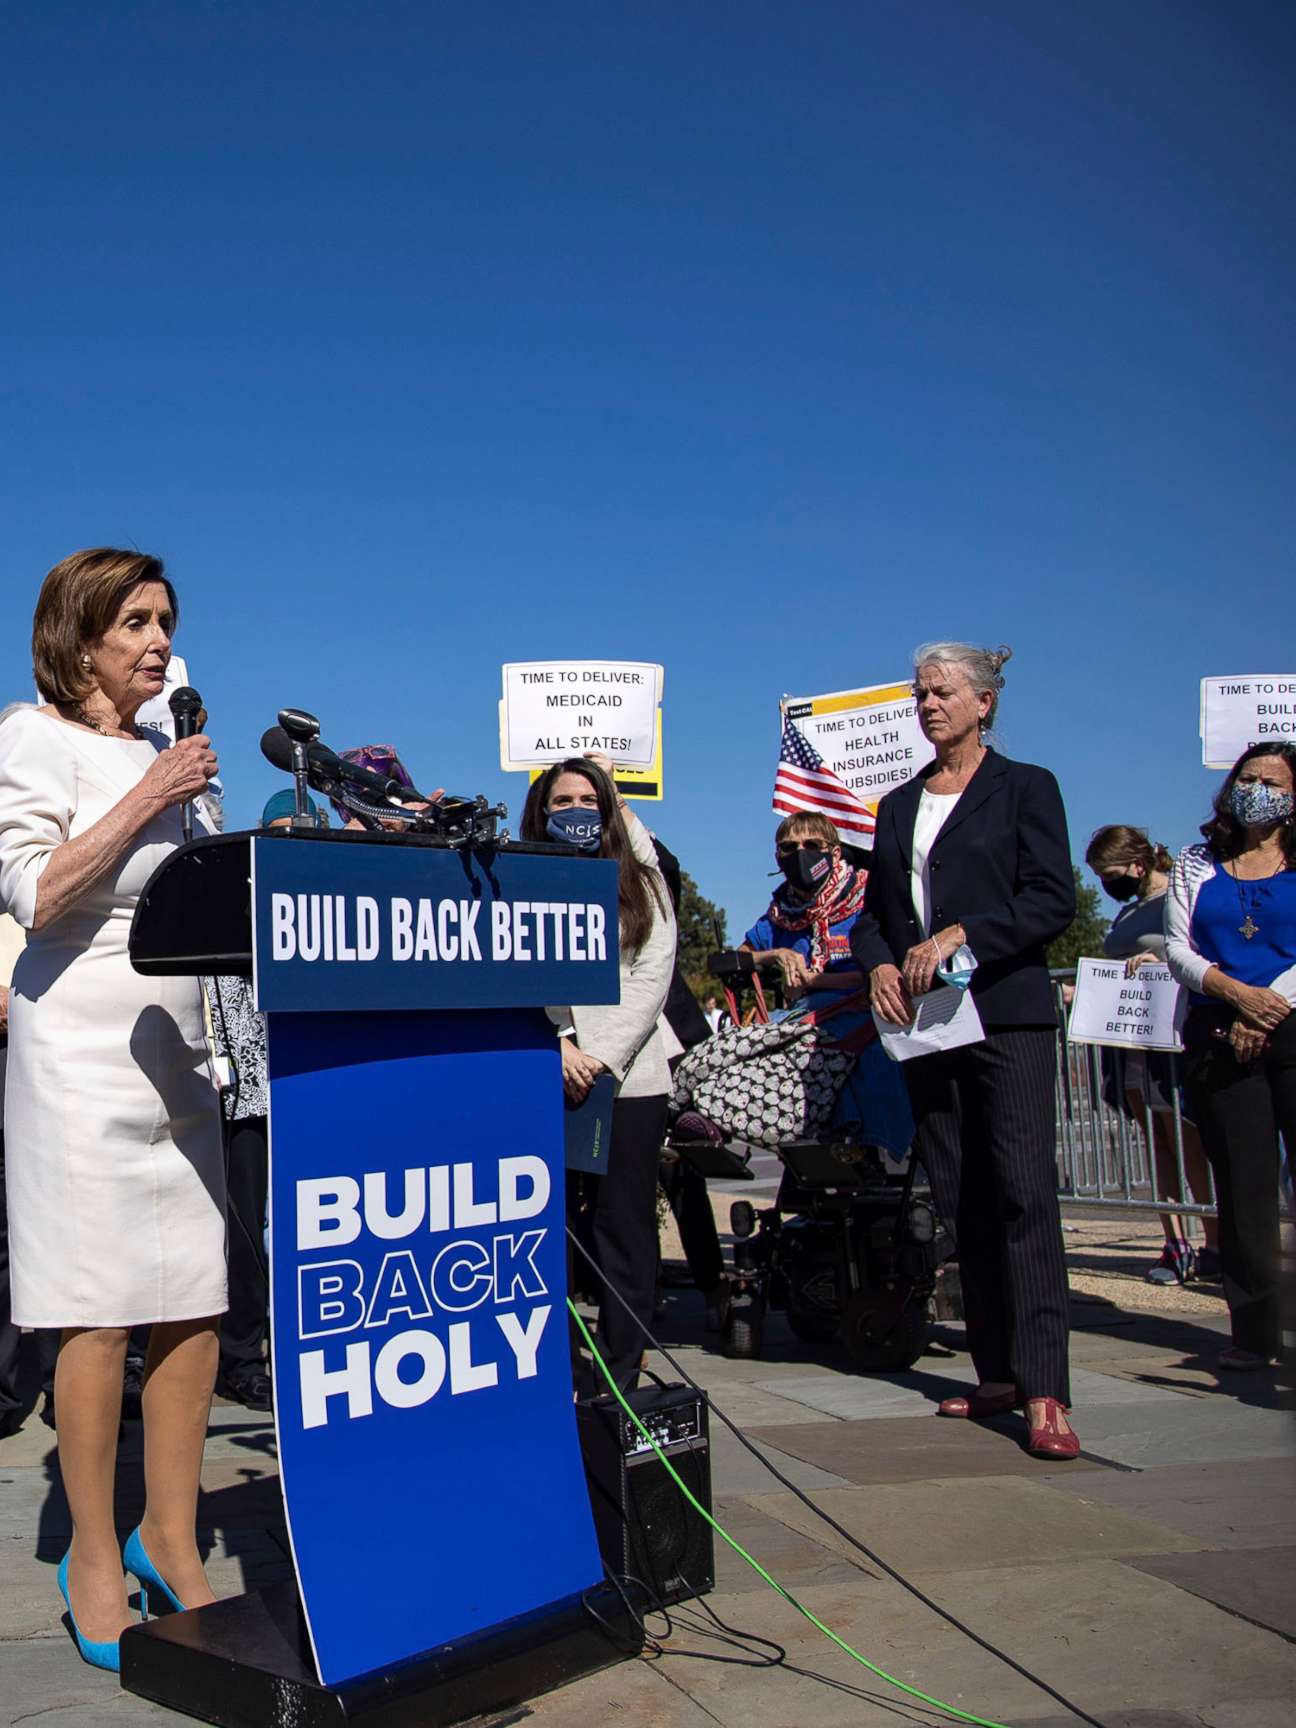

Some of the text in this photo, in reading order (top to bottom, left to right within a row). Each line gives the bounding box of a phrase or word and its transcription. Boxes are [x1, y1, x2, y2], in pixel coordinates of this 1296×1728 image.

[520, 671, 644, 685] TIME TO DELIVER:
[1219, 685, 1251, 695] TIME
[1255, 684, 1274, 693] TO
[546, 694, 623, 707] MEDICAID
[578, 715, 593, 727] IN
[815, 720, 845, 734] TIME
[848, 717, 865, 729] TO
[535, 736, 632, 751] ALL STATES!
[845, 731, 899, 752] HEALTH
[833, 747, 913, 772] INSURANCE
[842, 768, 913, 790] UBSIDIES!
[271, 893, 606, 961] BUILD BACK BETTER
[1092, 968, 1119, 979] TIME
[1120, 989, 1152, 1000] BUILD
[1117, 1006, 1149, 1018] BACK
[1106, 1021, 1154, 1035] BETTER!
[296, 1155, 551, 1250] BUILD
[297, 1228, 549, 1340] BACK
[299, 1304, 552, 1430] HOLY
